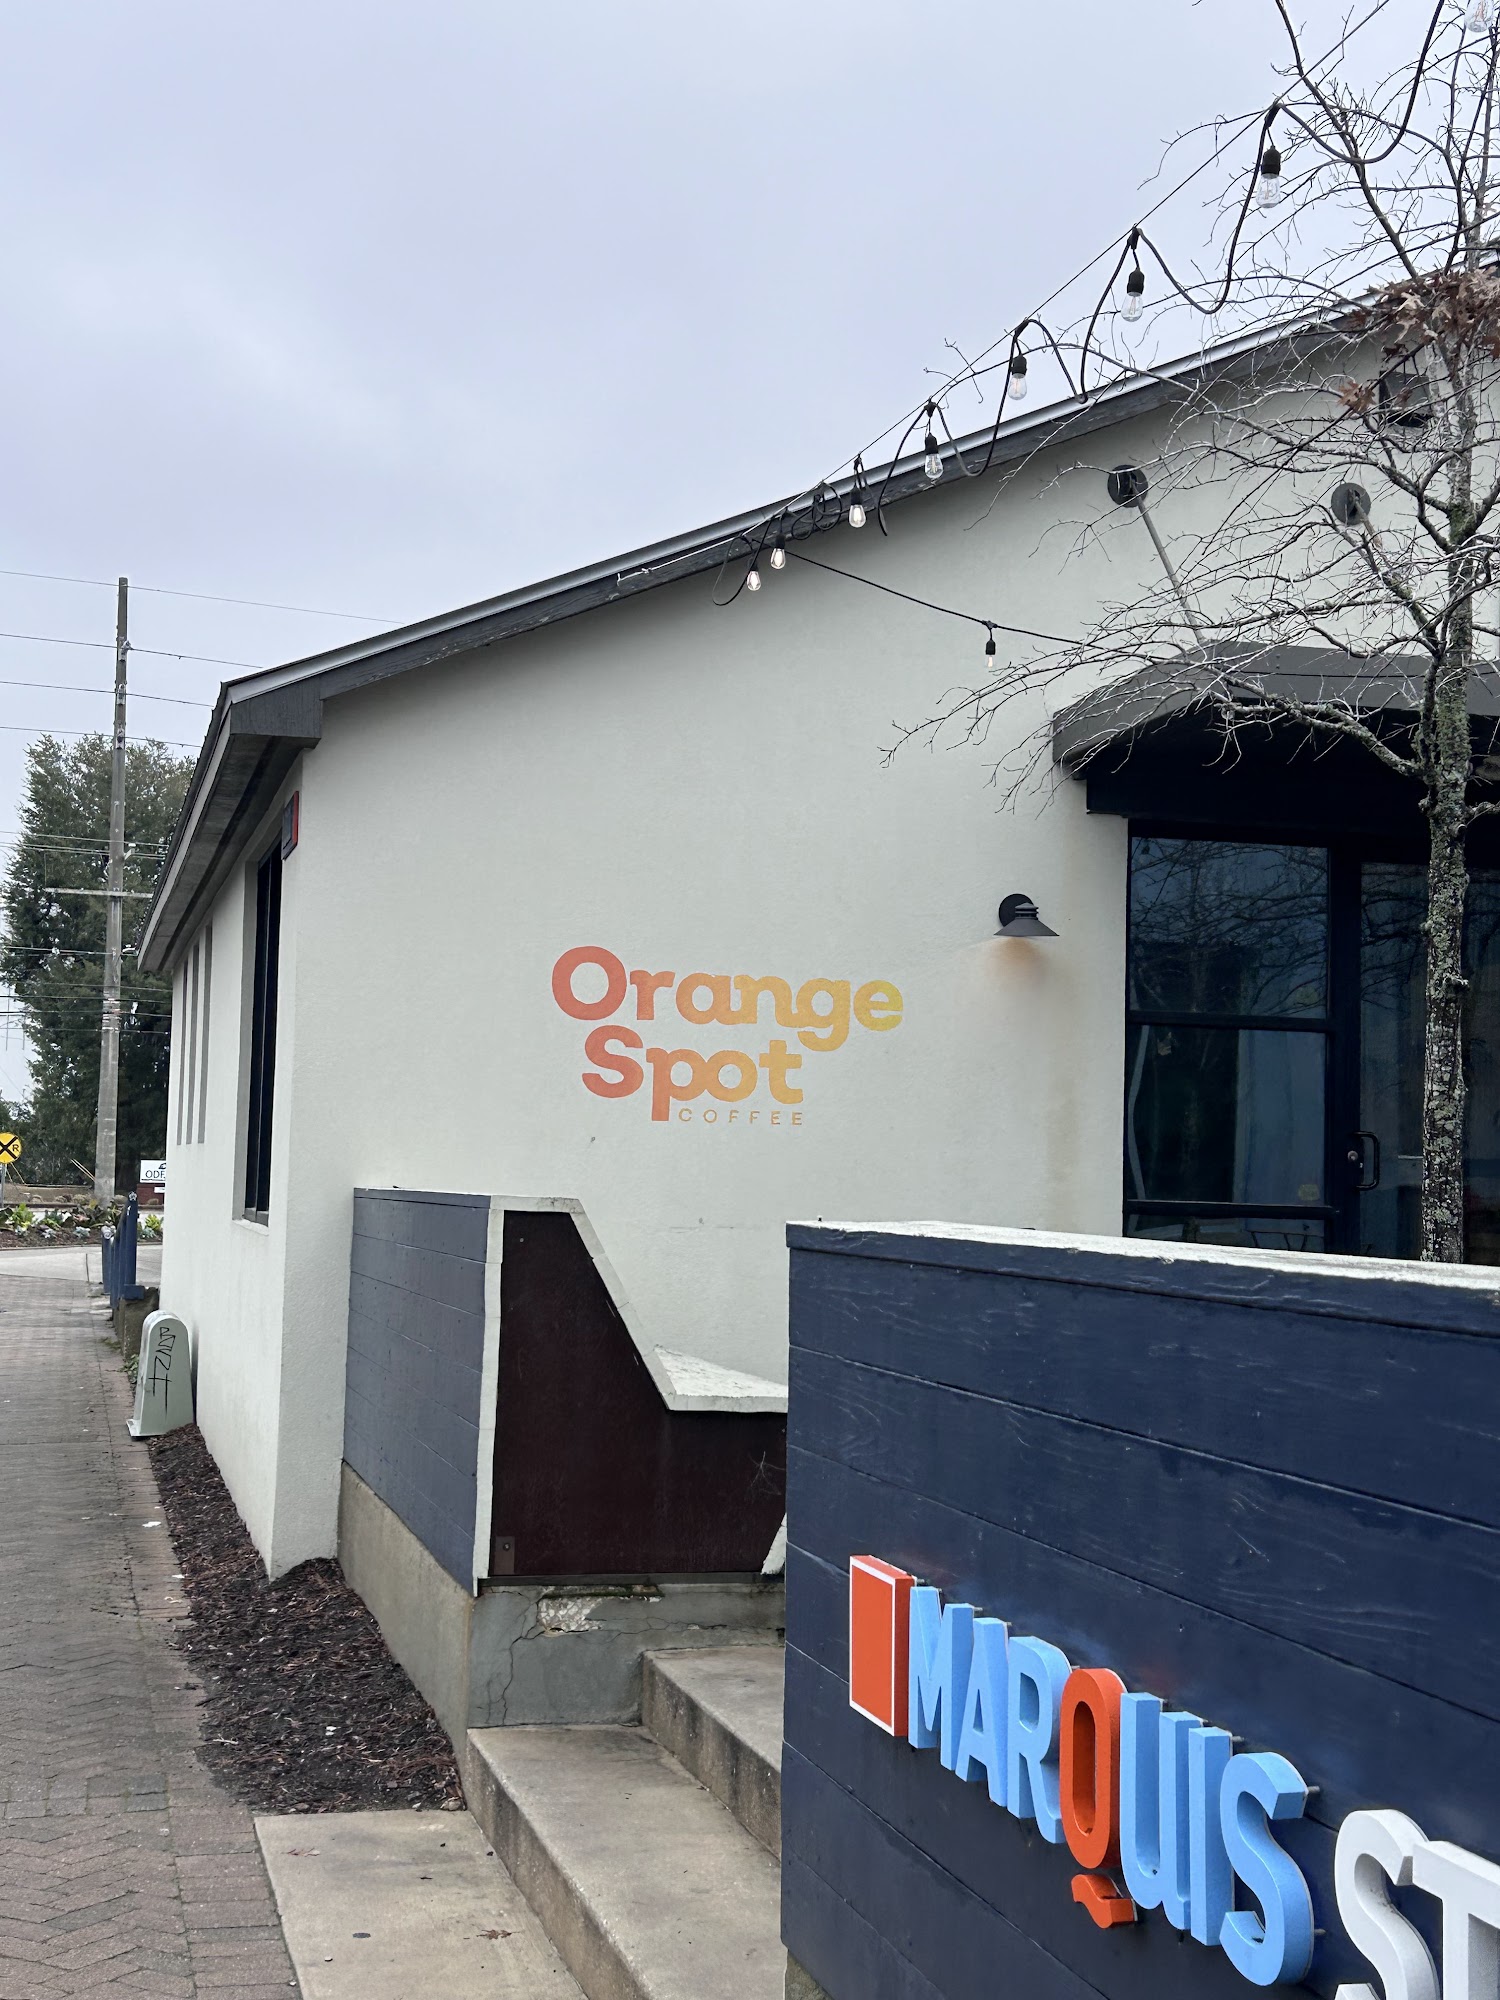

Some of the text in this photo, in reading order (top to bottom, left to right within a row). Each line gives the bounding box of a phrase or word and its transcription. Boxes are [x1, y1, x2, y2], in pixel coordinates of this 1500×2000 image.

[551, 945, 904, 1052] Orange
[581, 1024, 804, 1121] Spot
[678, 1107, 803, 1126] COFFEE
[908, 1585, 1315, 1987] MARQUIS
